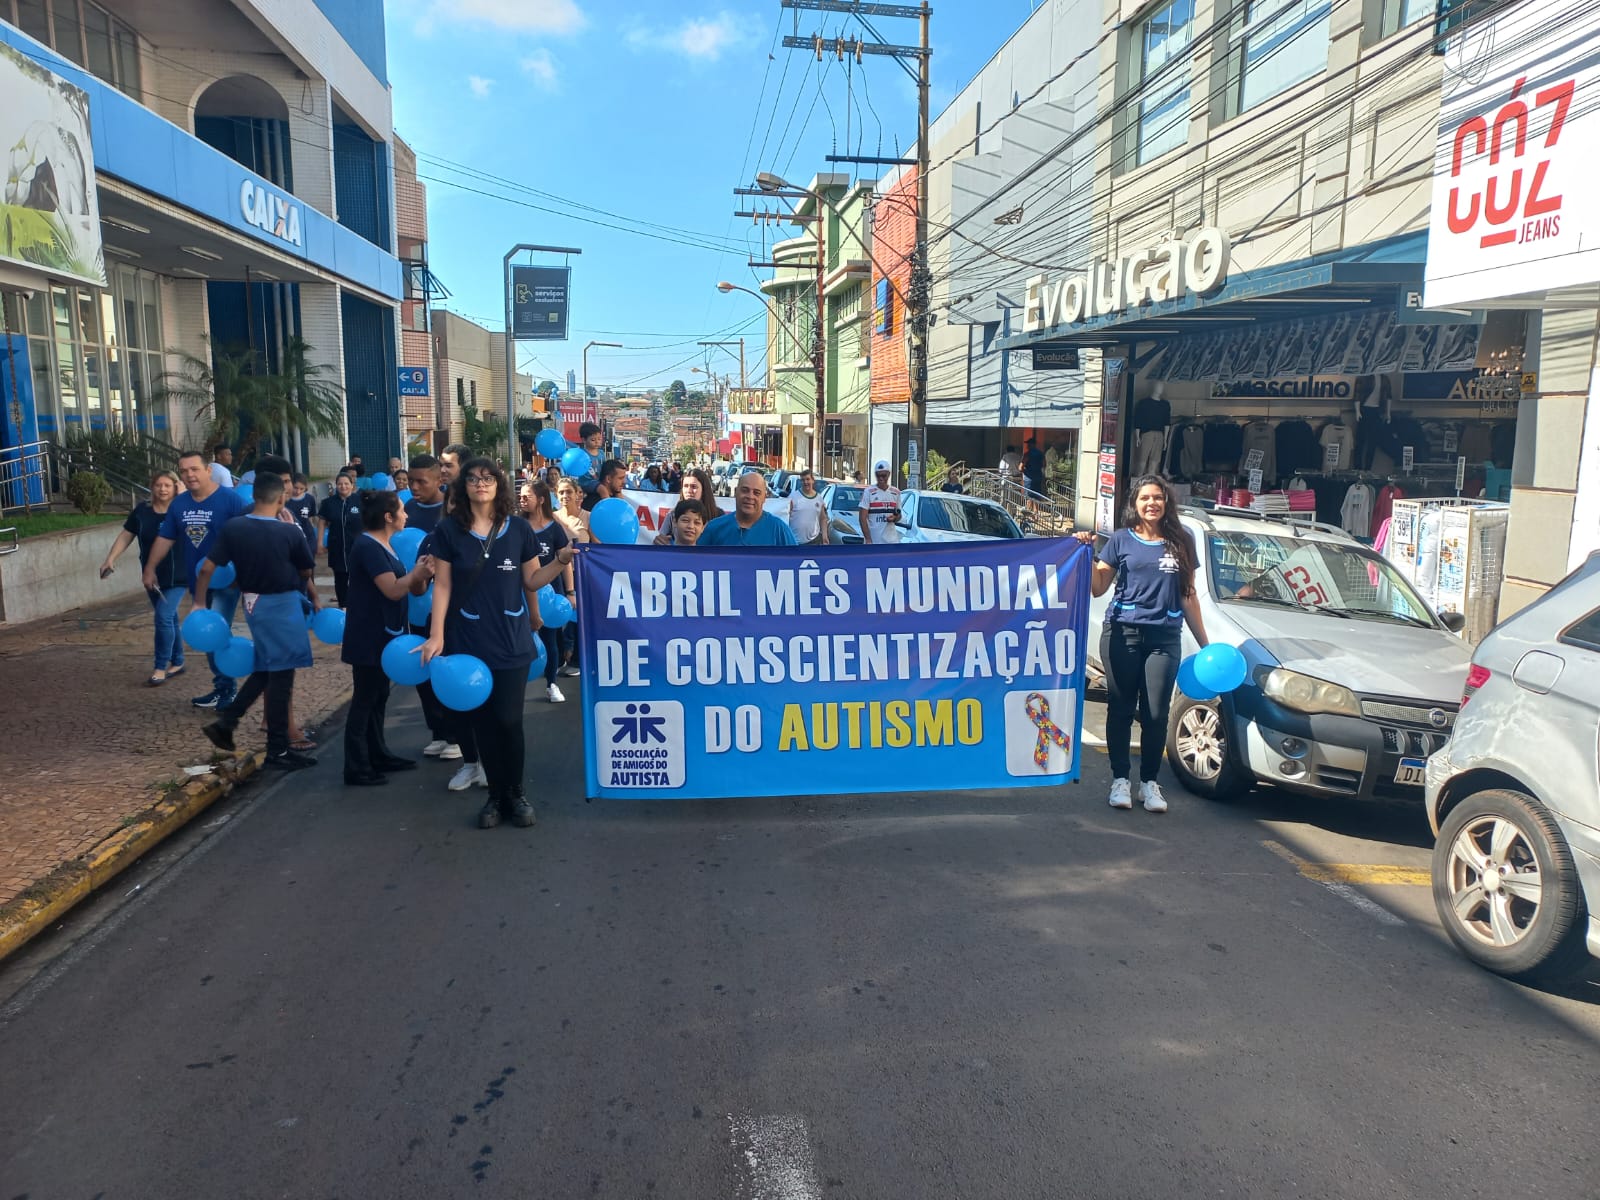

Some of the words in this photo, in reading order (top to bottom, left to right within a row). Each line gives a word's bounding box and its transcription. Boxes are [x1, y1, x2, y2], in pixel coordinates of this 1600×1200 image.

[241, 179, 301, 247] CAIXA
[1519, 215, 1561, 244] JEANS
[1022, 226, 1230, 333] Evolução
[1036, 353, 1076, 362] Evolução
[606, 570, 741, 619] ABRIL
[756, 560, 850, 616] MÊS
[866, 564, 1068, 614] MUNDIAL
[597, 638, 651, 687] DE
[665, 620, 1076, 686] CONSCIENTIZAÇÃO
[704, 704, 762, 754] DO
[778, 698, 984, 751] AUTISMO
[610, 747, 668, 760] ASSOCIAÇÃO
[612, 760, 622, 770] DE
[623, 760, 654, 770] AMIGOS
[656, 760, 668, 770] DO
[610, 771, 670, 786] AUTISTA
[1403, 767, 1425, 783] DI
